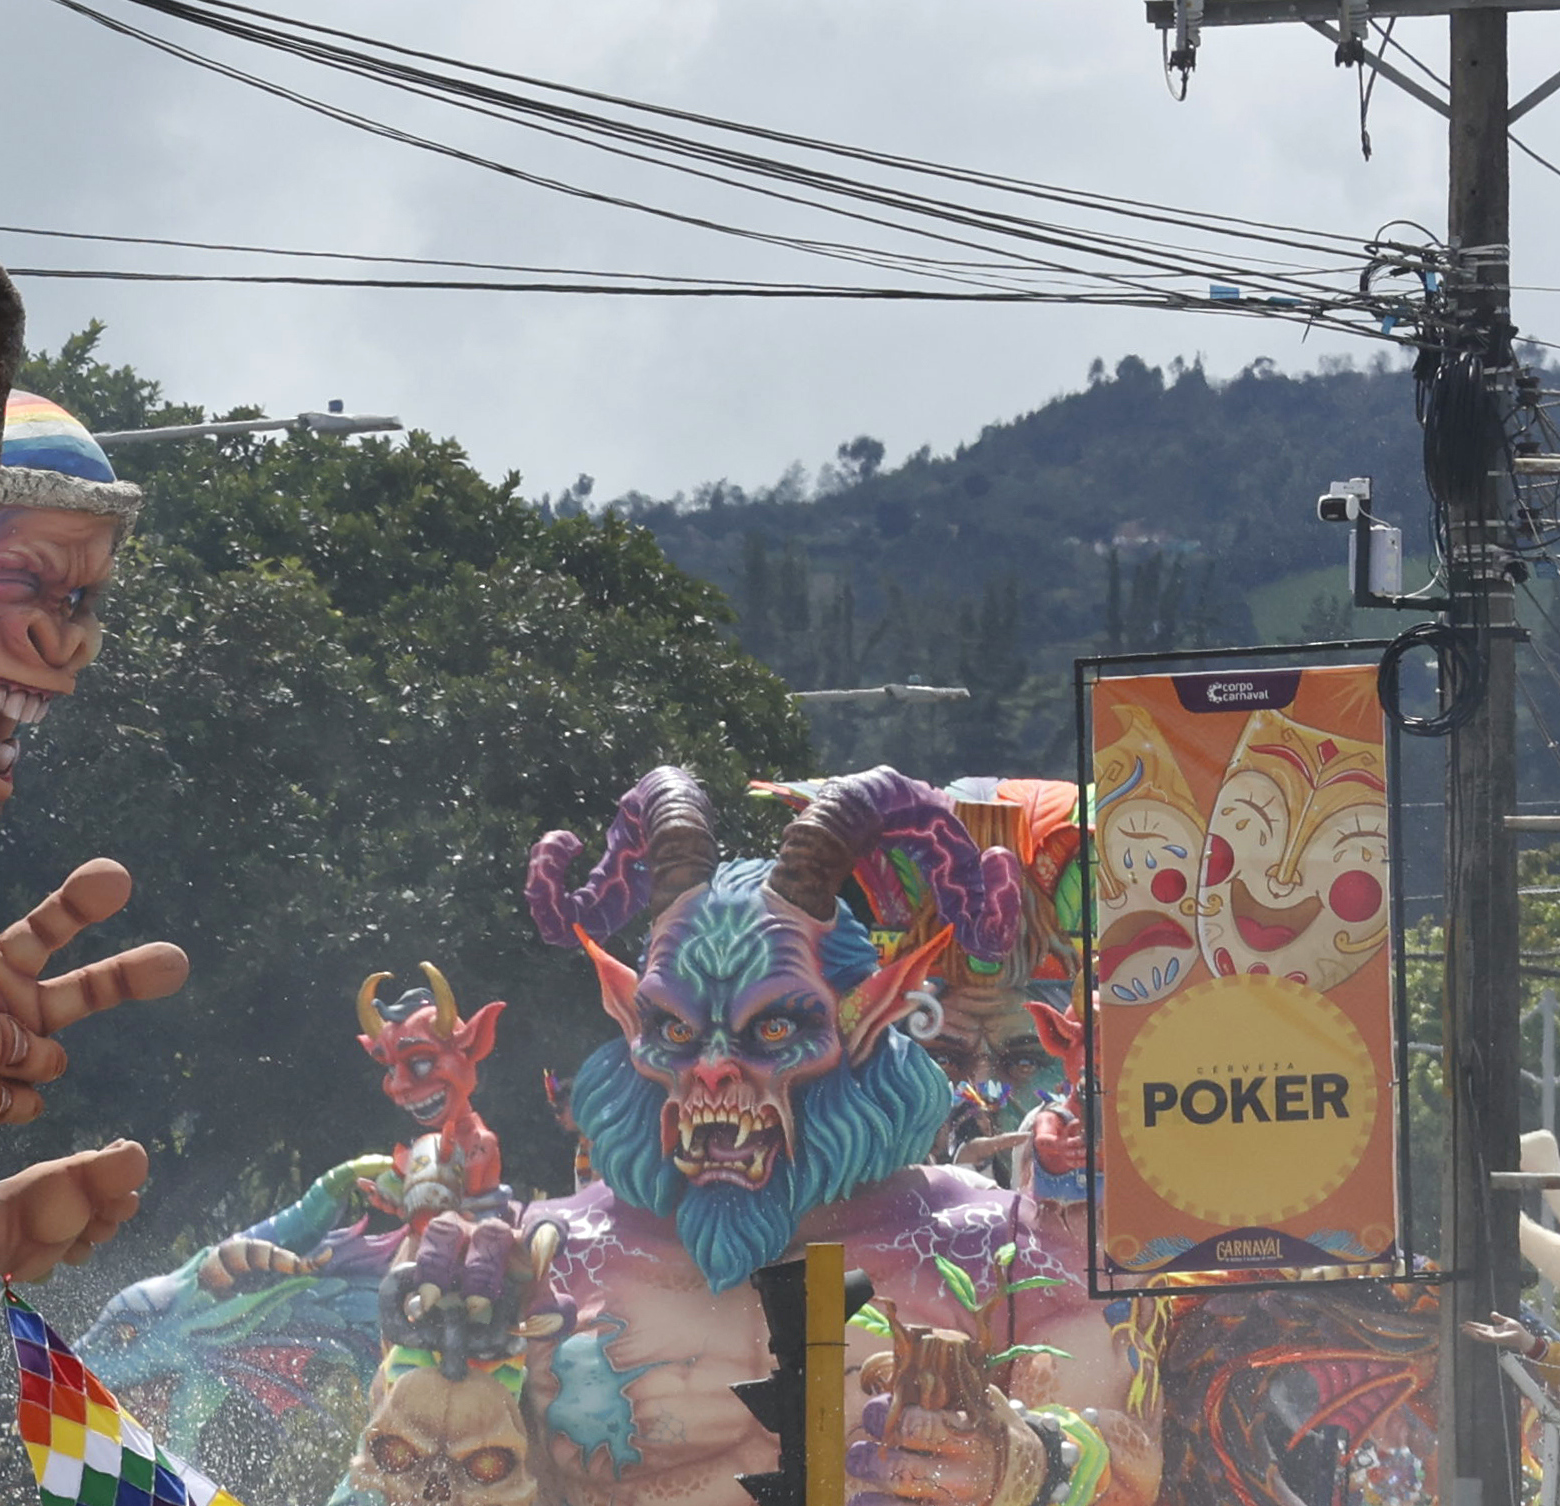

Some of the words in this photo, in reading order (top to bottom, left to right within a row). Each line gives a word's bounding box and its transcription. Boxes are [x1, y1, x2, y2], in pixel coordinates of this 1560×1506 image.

[1222, 682, 1254, 693] corpo
[1222, 690, 1270, 701] carnaval
[1197, 1062, 1295, 1075] CERVEZA
[1143, 1073, 1350, 1128] POKER
[1216, 1236, 1284, 1261] CARNAVAL
